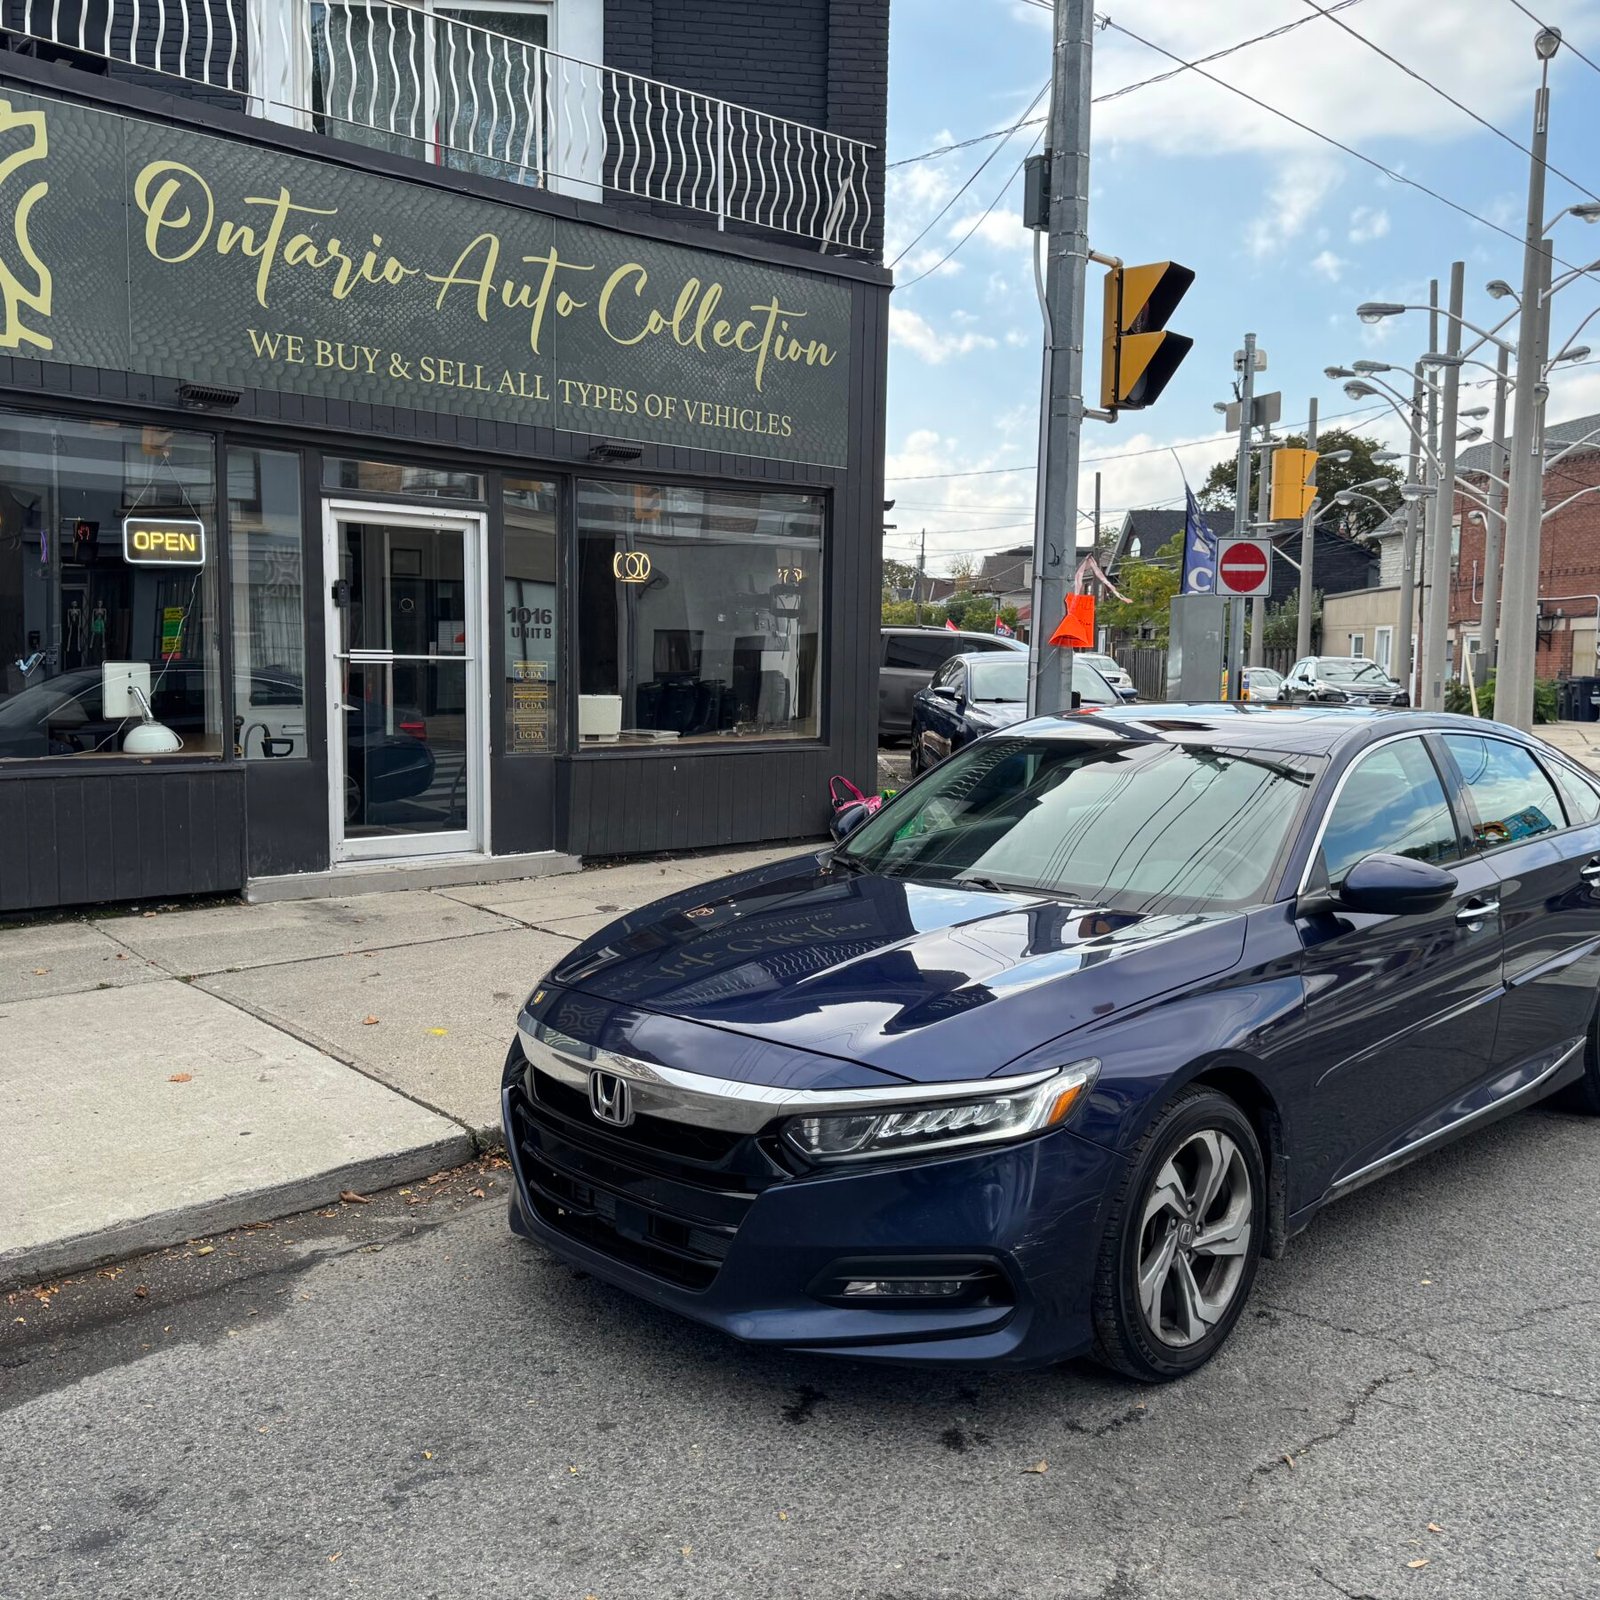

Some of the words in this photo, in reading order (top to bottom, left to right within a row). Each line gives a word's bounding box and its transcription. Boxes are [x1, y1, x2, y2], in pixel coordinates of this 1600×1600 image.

[134, 160, 420, 308] Ontario
[425, 233, 595, 355] Auto
[598, 263, 837, 392] Collection
[246, 328, 305, 364] WE
[314, 339, 381, 374] BUY
[389, 352, 413, 380] &
[419, 356, 491, 391] SELL
[496, 369, 550, 400] ALL
[557, 378, 638, 414] TYPES
[644, 393, 677, 419] OF
[683, 399, 792, 437] VEHICLES
[133, 531, 196, 552] OPEN
[507, 607, 552, 625] 1016
[511, 627, 542, 639] UNIT
[544, 627, 552, 639] B
[519, 670, 543, 679] UCDA
[519, 701, 543, 710] UCDA
[519, 730, 544, 739] UCDA
